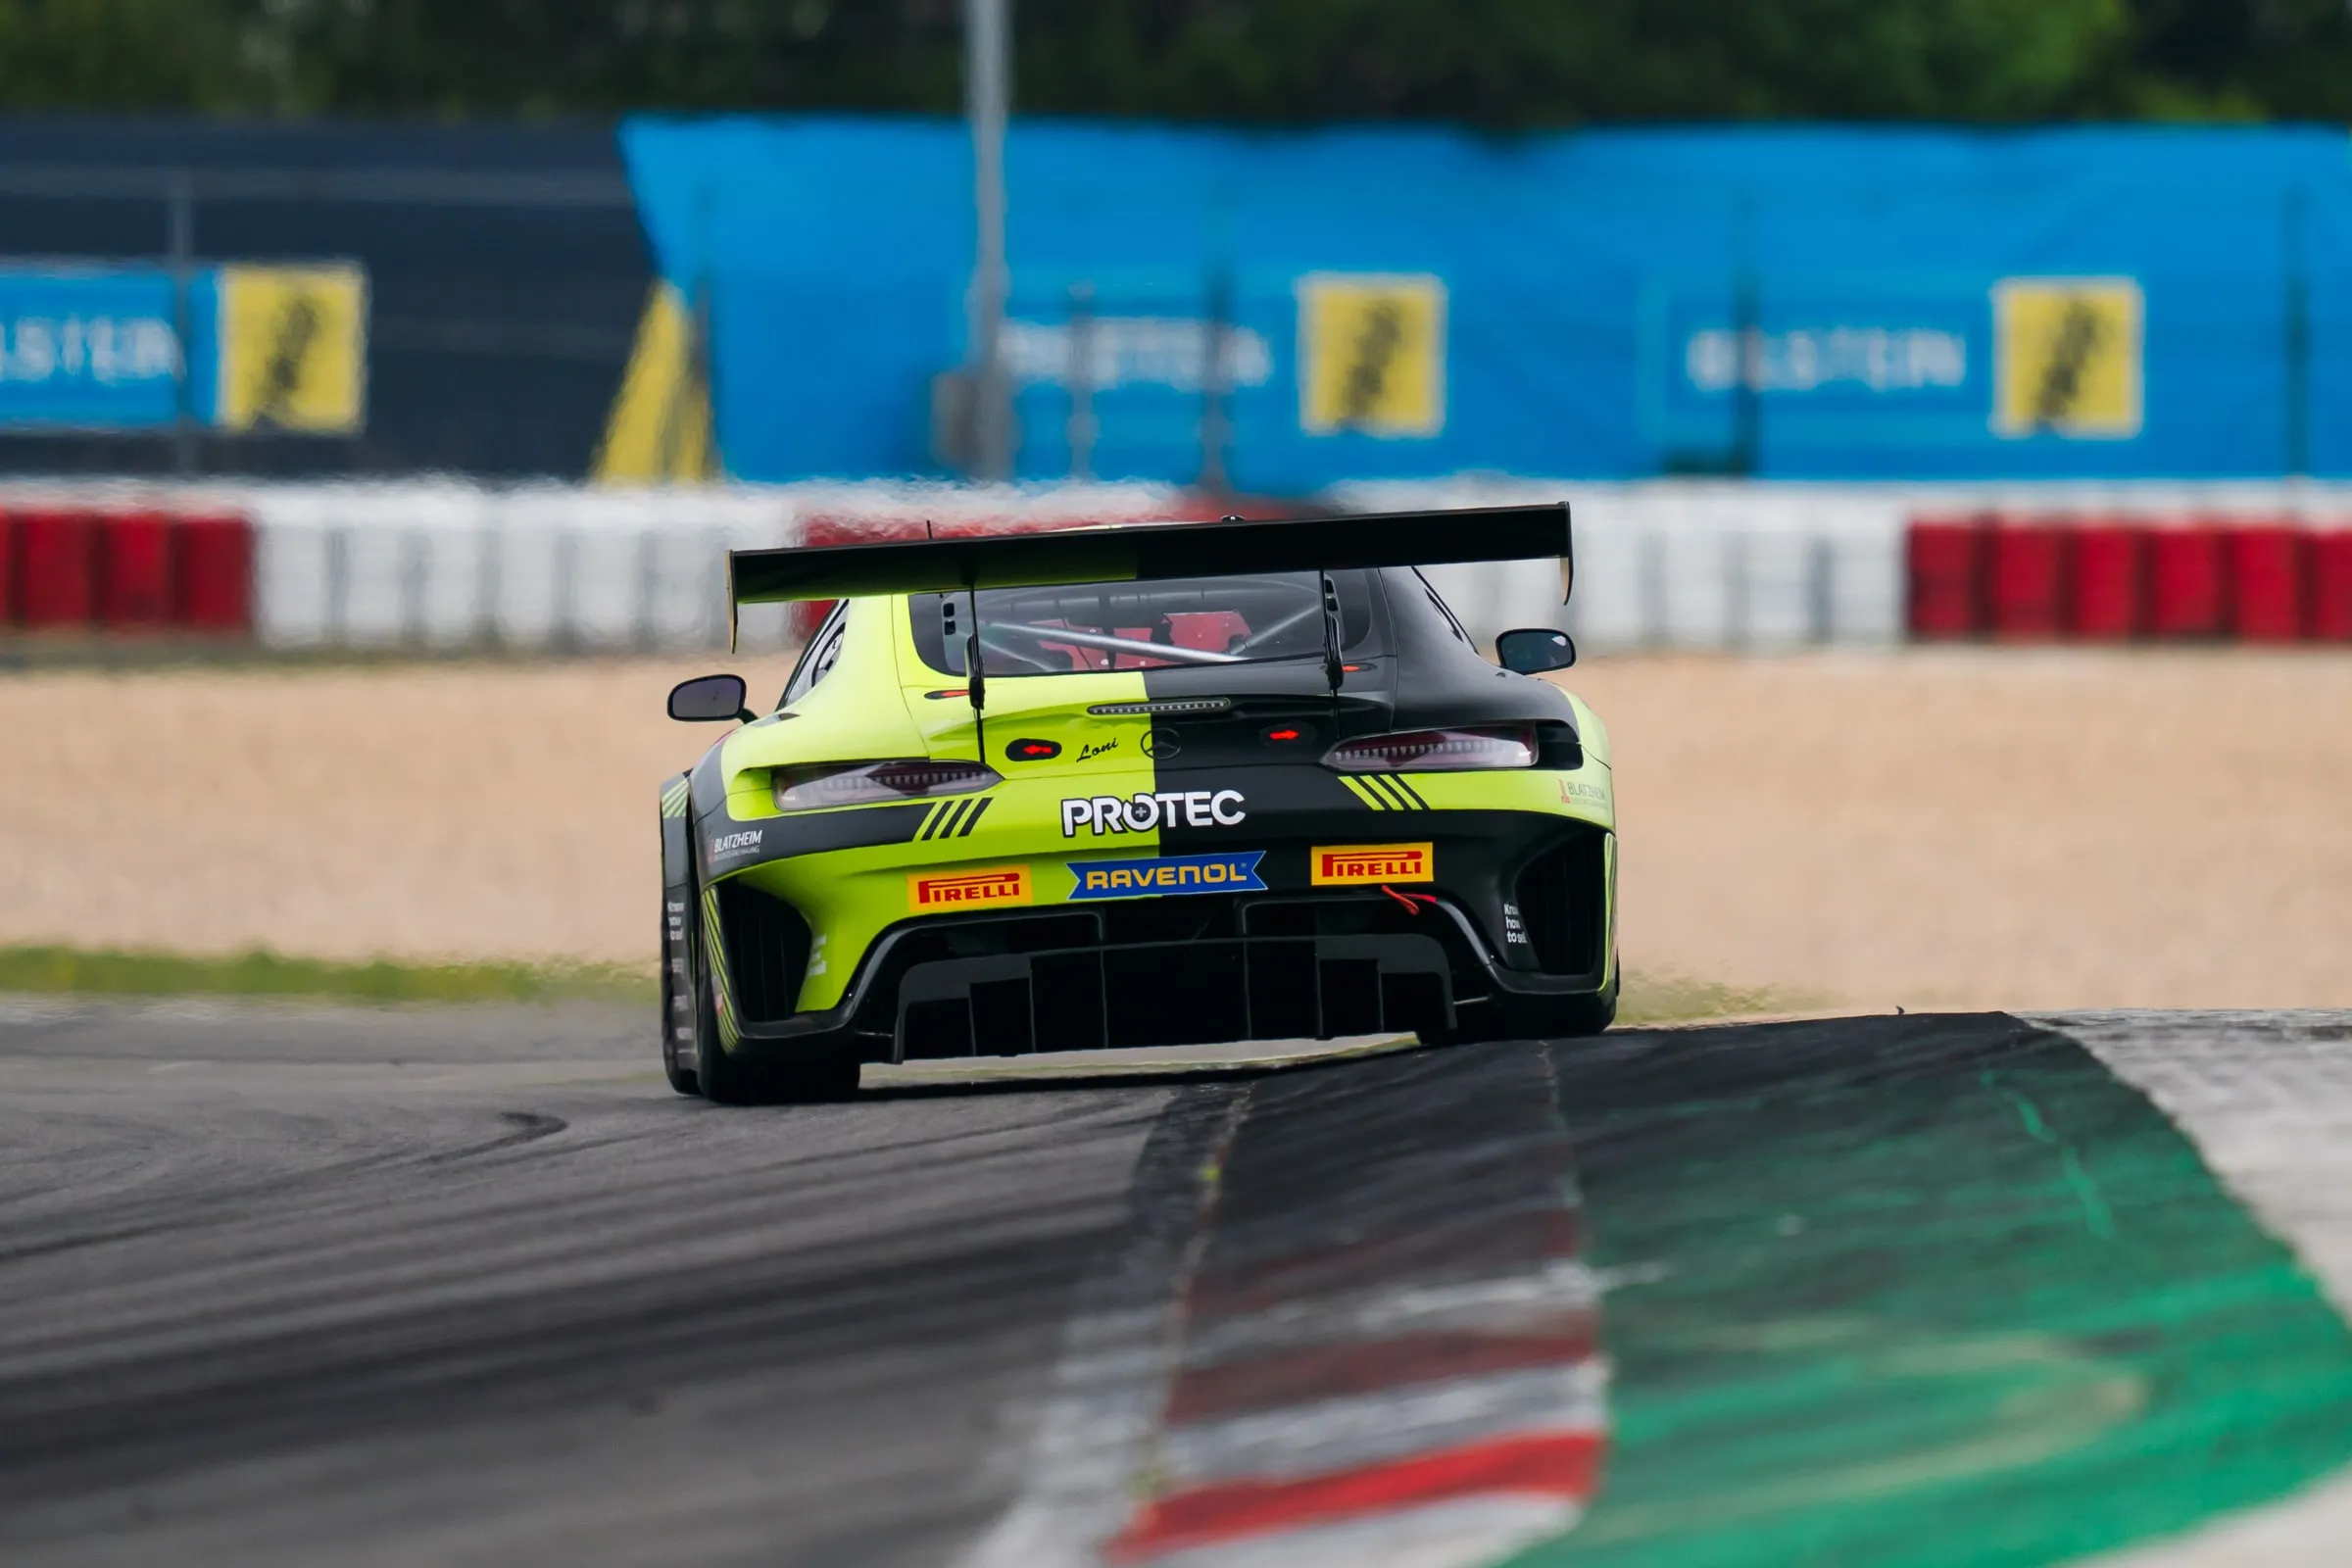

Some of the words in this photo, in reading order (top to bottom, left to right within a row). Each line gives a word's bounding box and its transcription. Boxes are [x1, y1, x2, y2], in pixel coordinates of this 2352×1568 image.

[1075, 737, 1119, 762] Loni
[1061, 789, 1247, 838] PROTEC
[713, 829, 763, 853] BLATZHEIM
[1086, 863, 1248, 891] RAVENOL
[1321, 850, 1423, 878] PIRELLI
[918, 872, 1021, 906] PIRELLI
